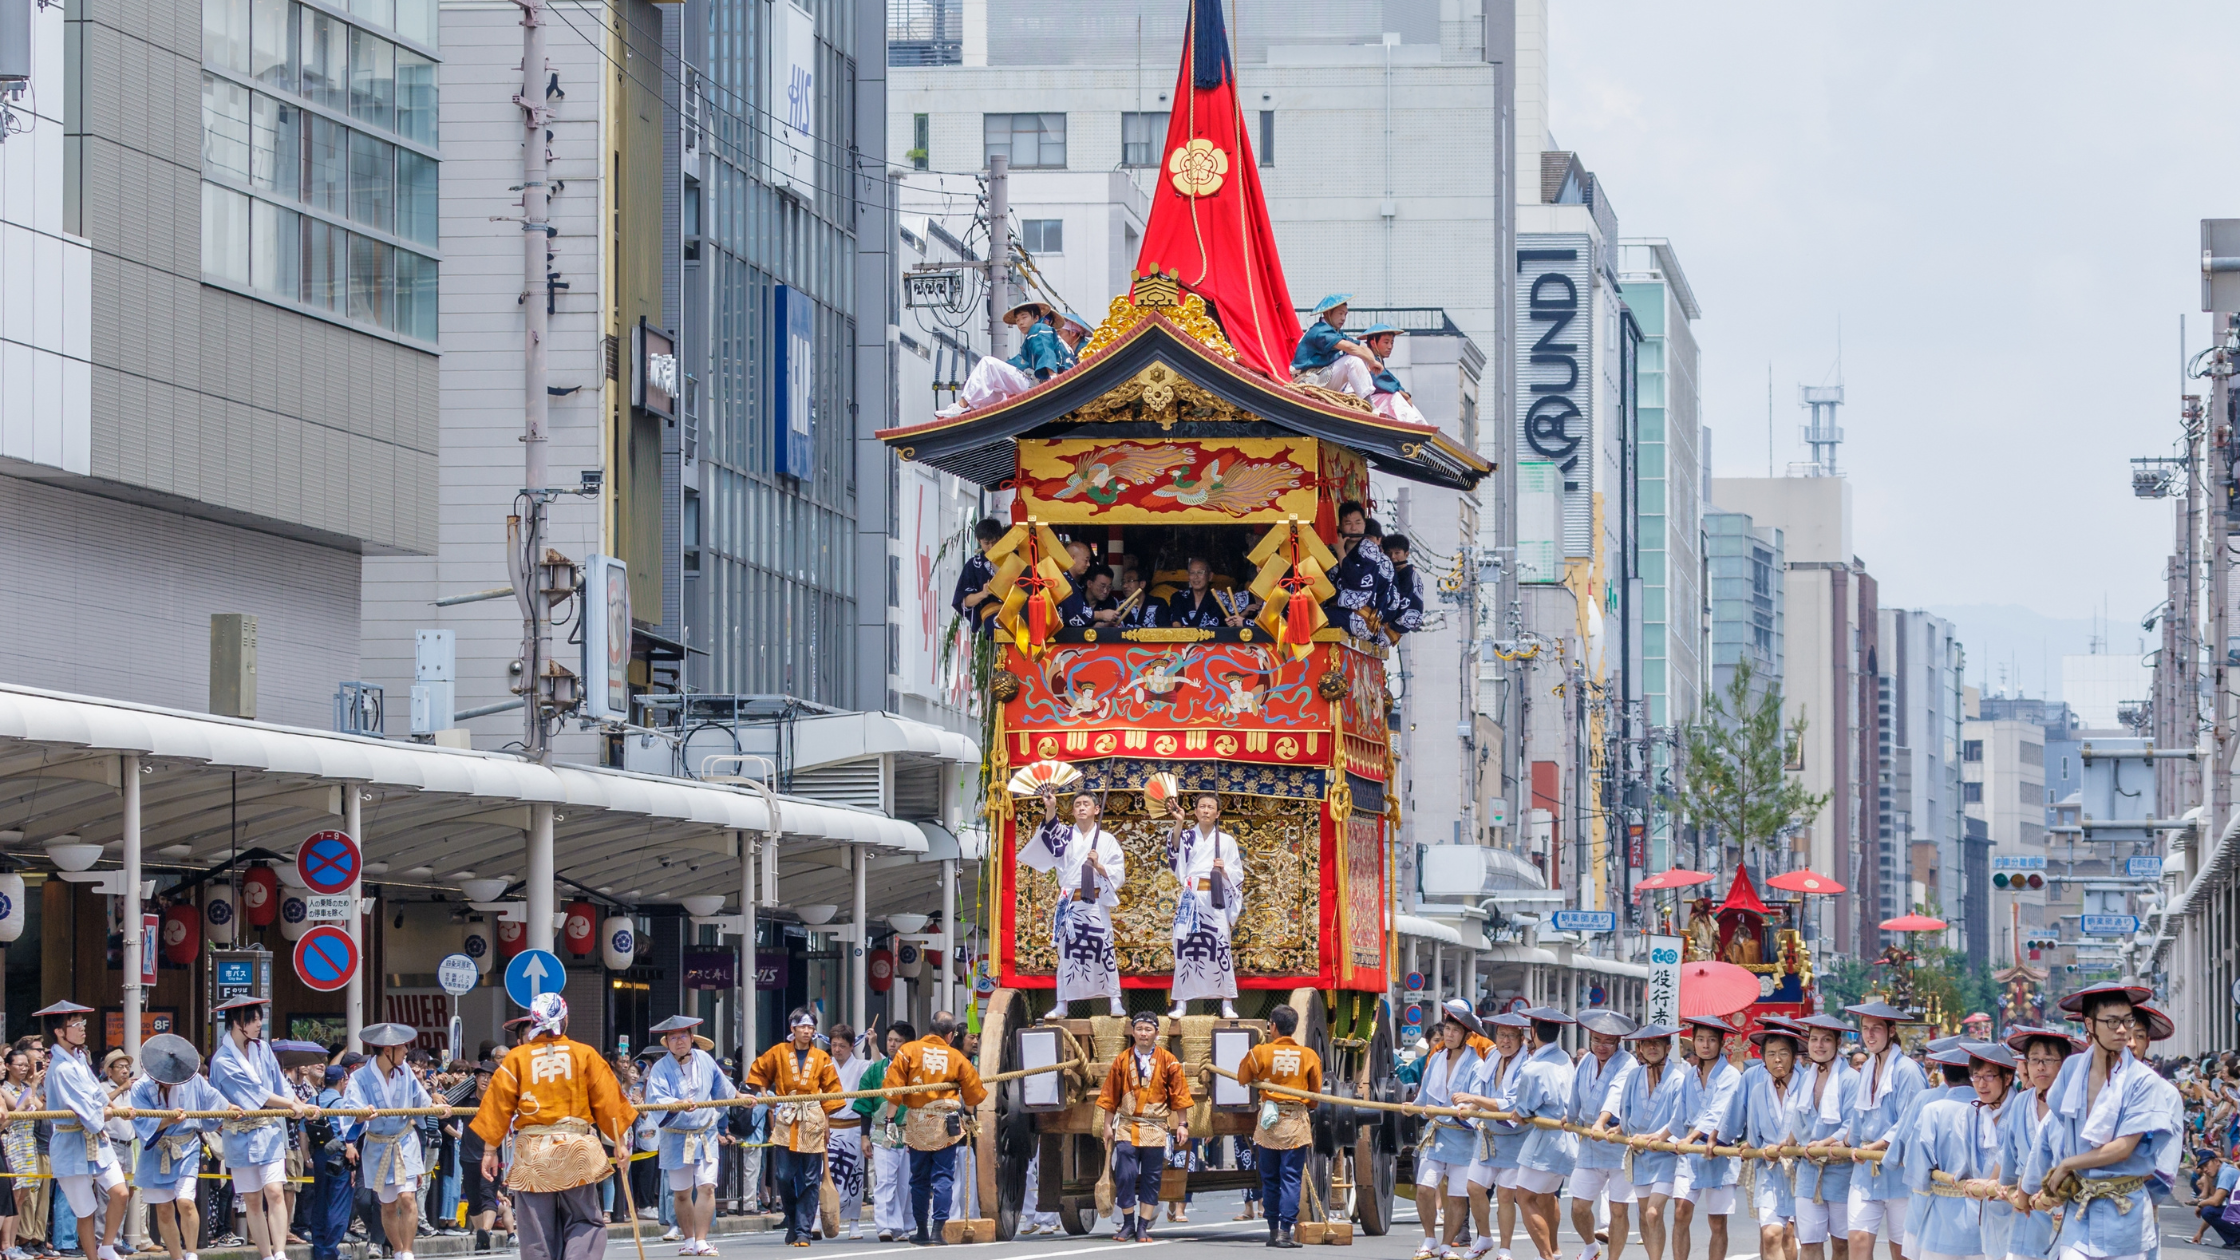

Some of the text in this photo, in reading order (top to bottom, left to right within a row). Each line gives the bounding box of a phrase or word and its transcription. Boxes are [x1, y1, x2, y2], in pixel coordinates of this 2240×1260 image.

[788, 63, 812, 138] HIS
[1517, 250, 1583, 491] OUND1
[309, 909, 344, 917] の停車を除く
[223, 988, 231, 997] F
[154, 1020, 170, 1030] 8F
[386, 995, 449, 1028] OWER
[531, 1043, 571, 1085] 南
[922, 1046, 949, 1075] 南
[1272, 1048, 1301, 1077] 南
